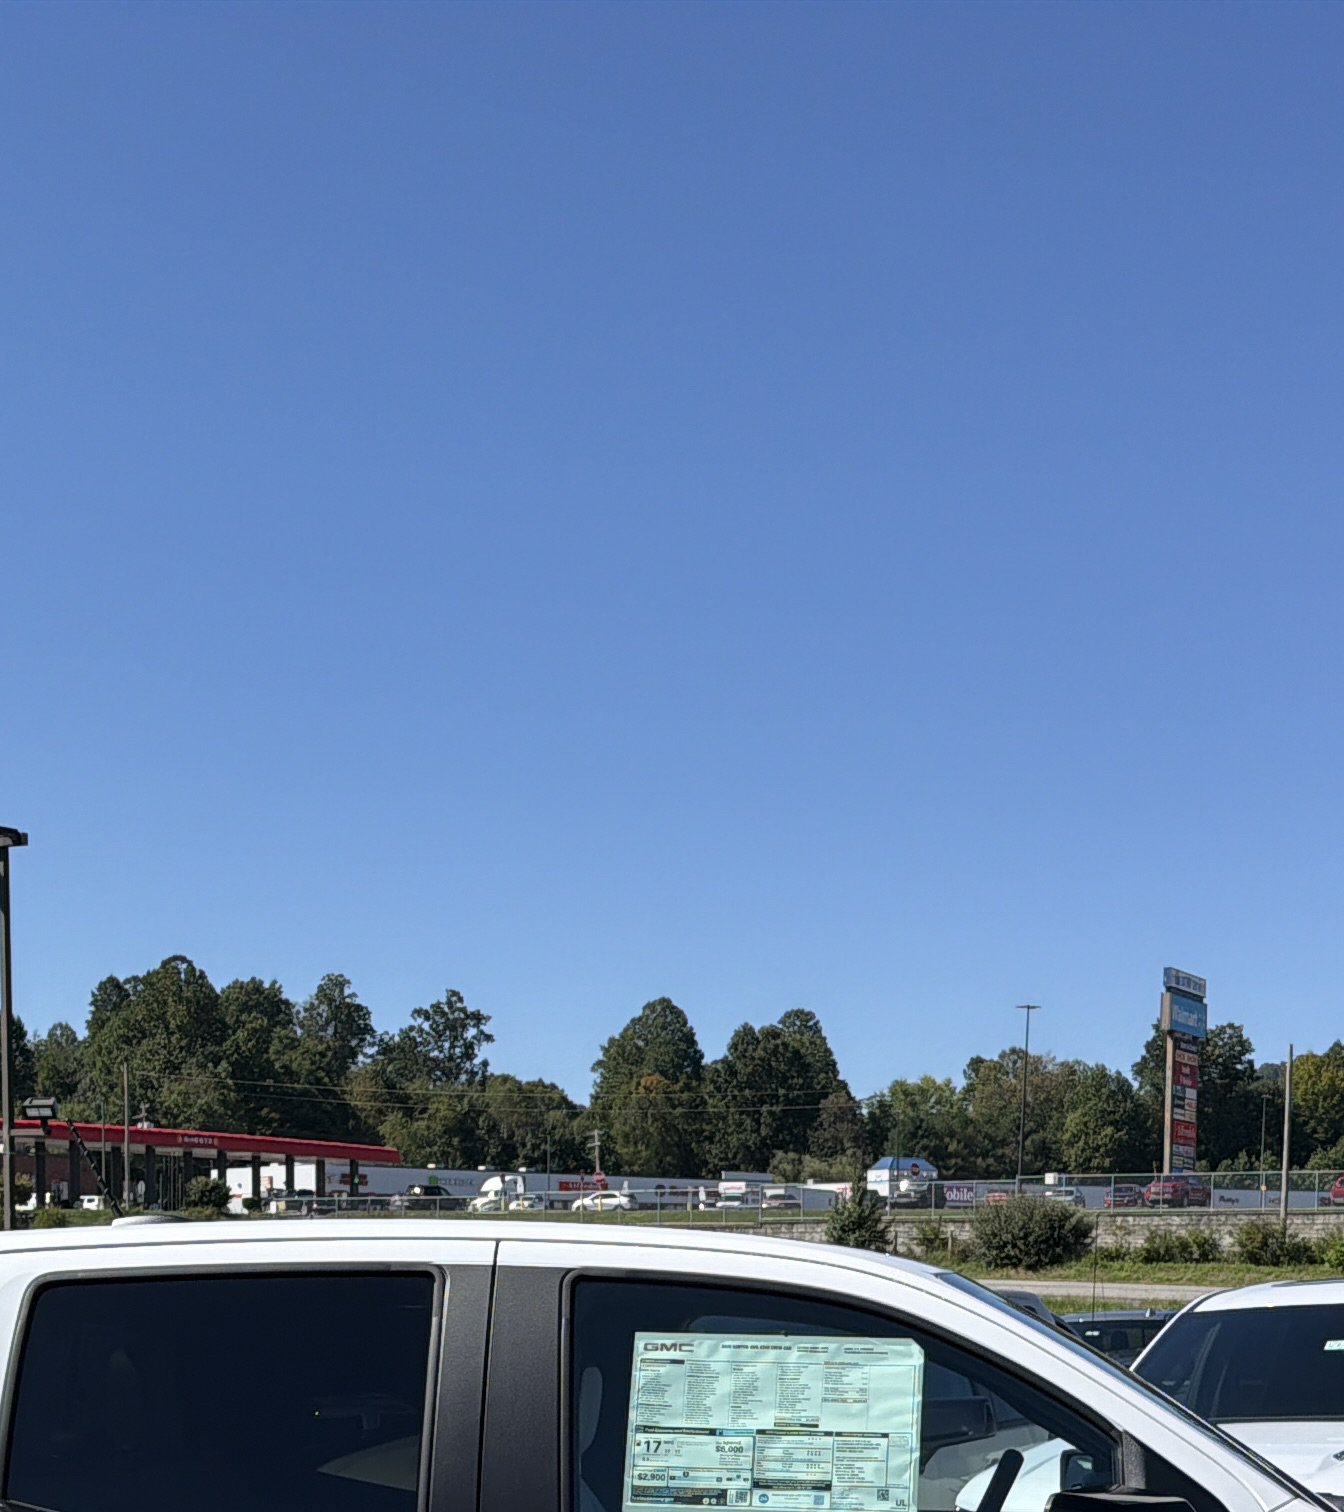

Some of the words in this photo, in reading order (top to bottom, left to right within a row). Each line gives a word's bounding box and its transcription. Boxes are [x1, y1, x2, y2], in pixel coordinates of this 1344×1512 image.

[943, 1187, 974, 1202] obile
[643, 1342, 695, 1353] GMC
[644, 1440, 662, 1453] 17
[637, 1473, 666, 1481] $2,900
